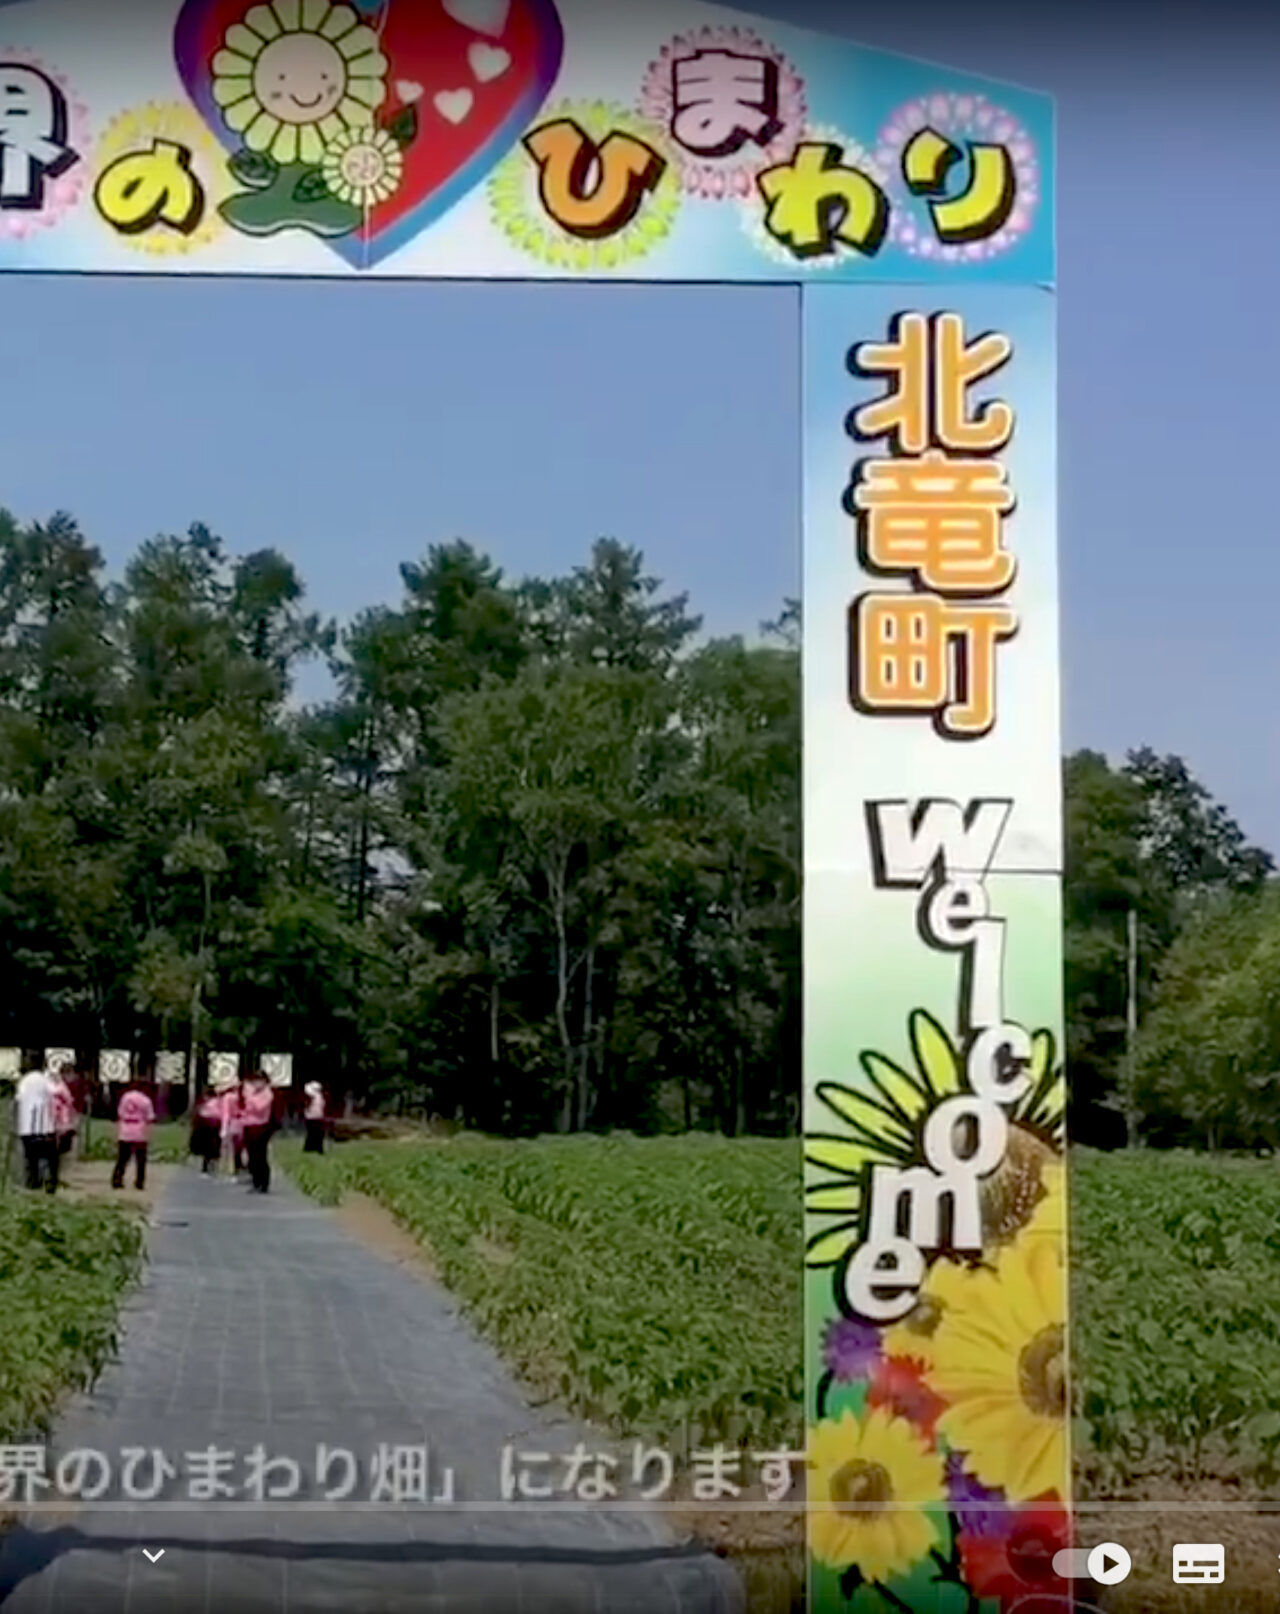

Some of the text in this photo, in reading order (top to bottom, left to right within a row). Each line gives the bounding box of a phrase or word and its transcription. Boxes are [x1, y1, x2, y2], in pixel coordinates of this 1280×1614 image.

[842, 309, 1019, 741] 北竜町
[831, 798, 1034, 1327] Welcome
